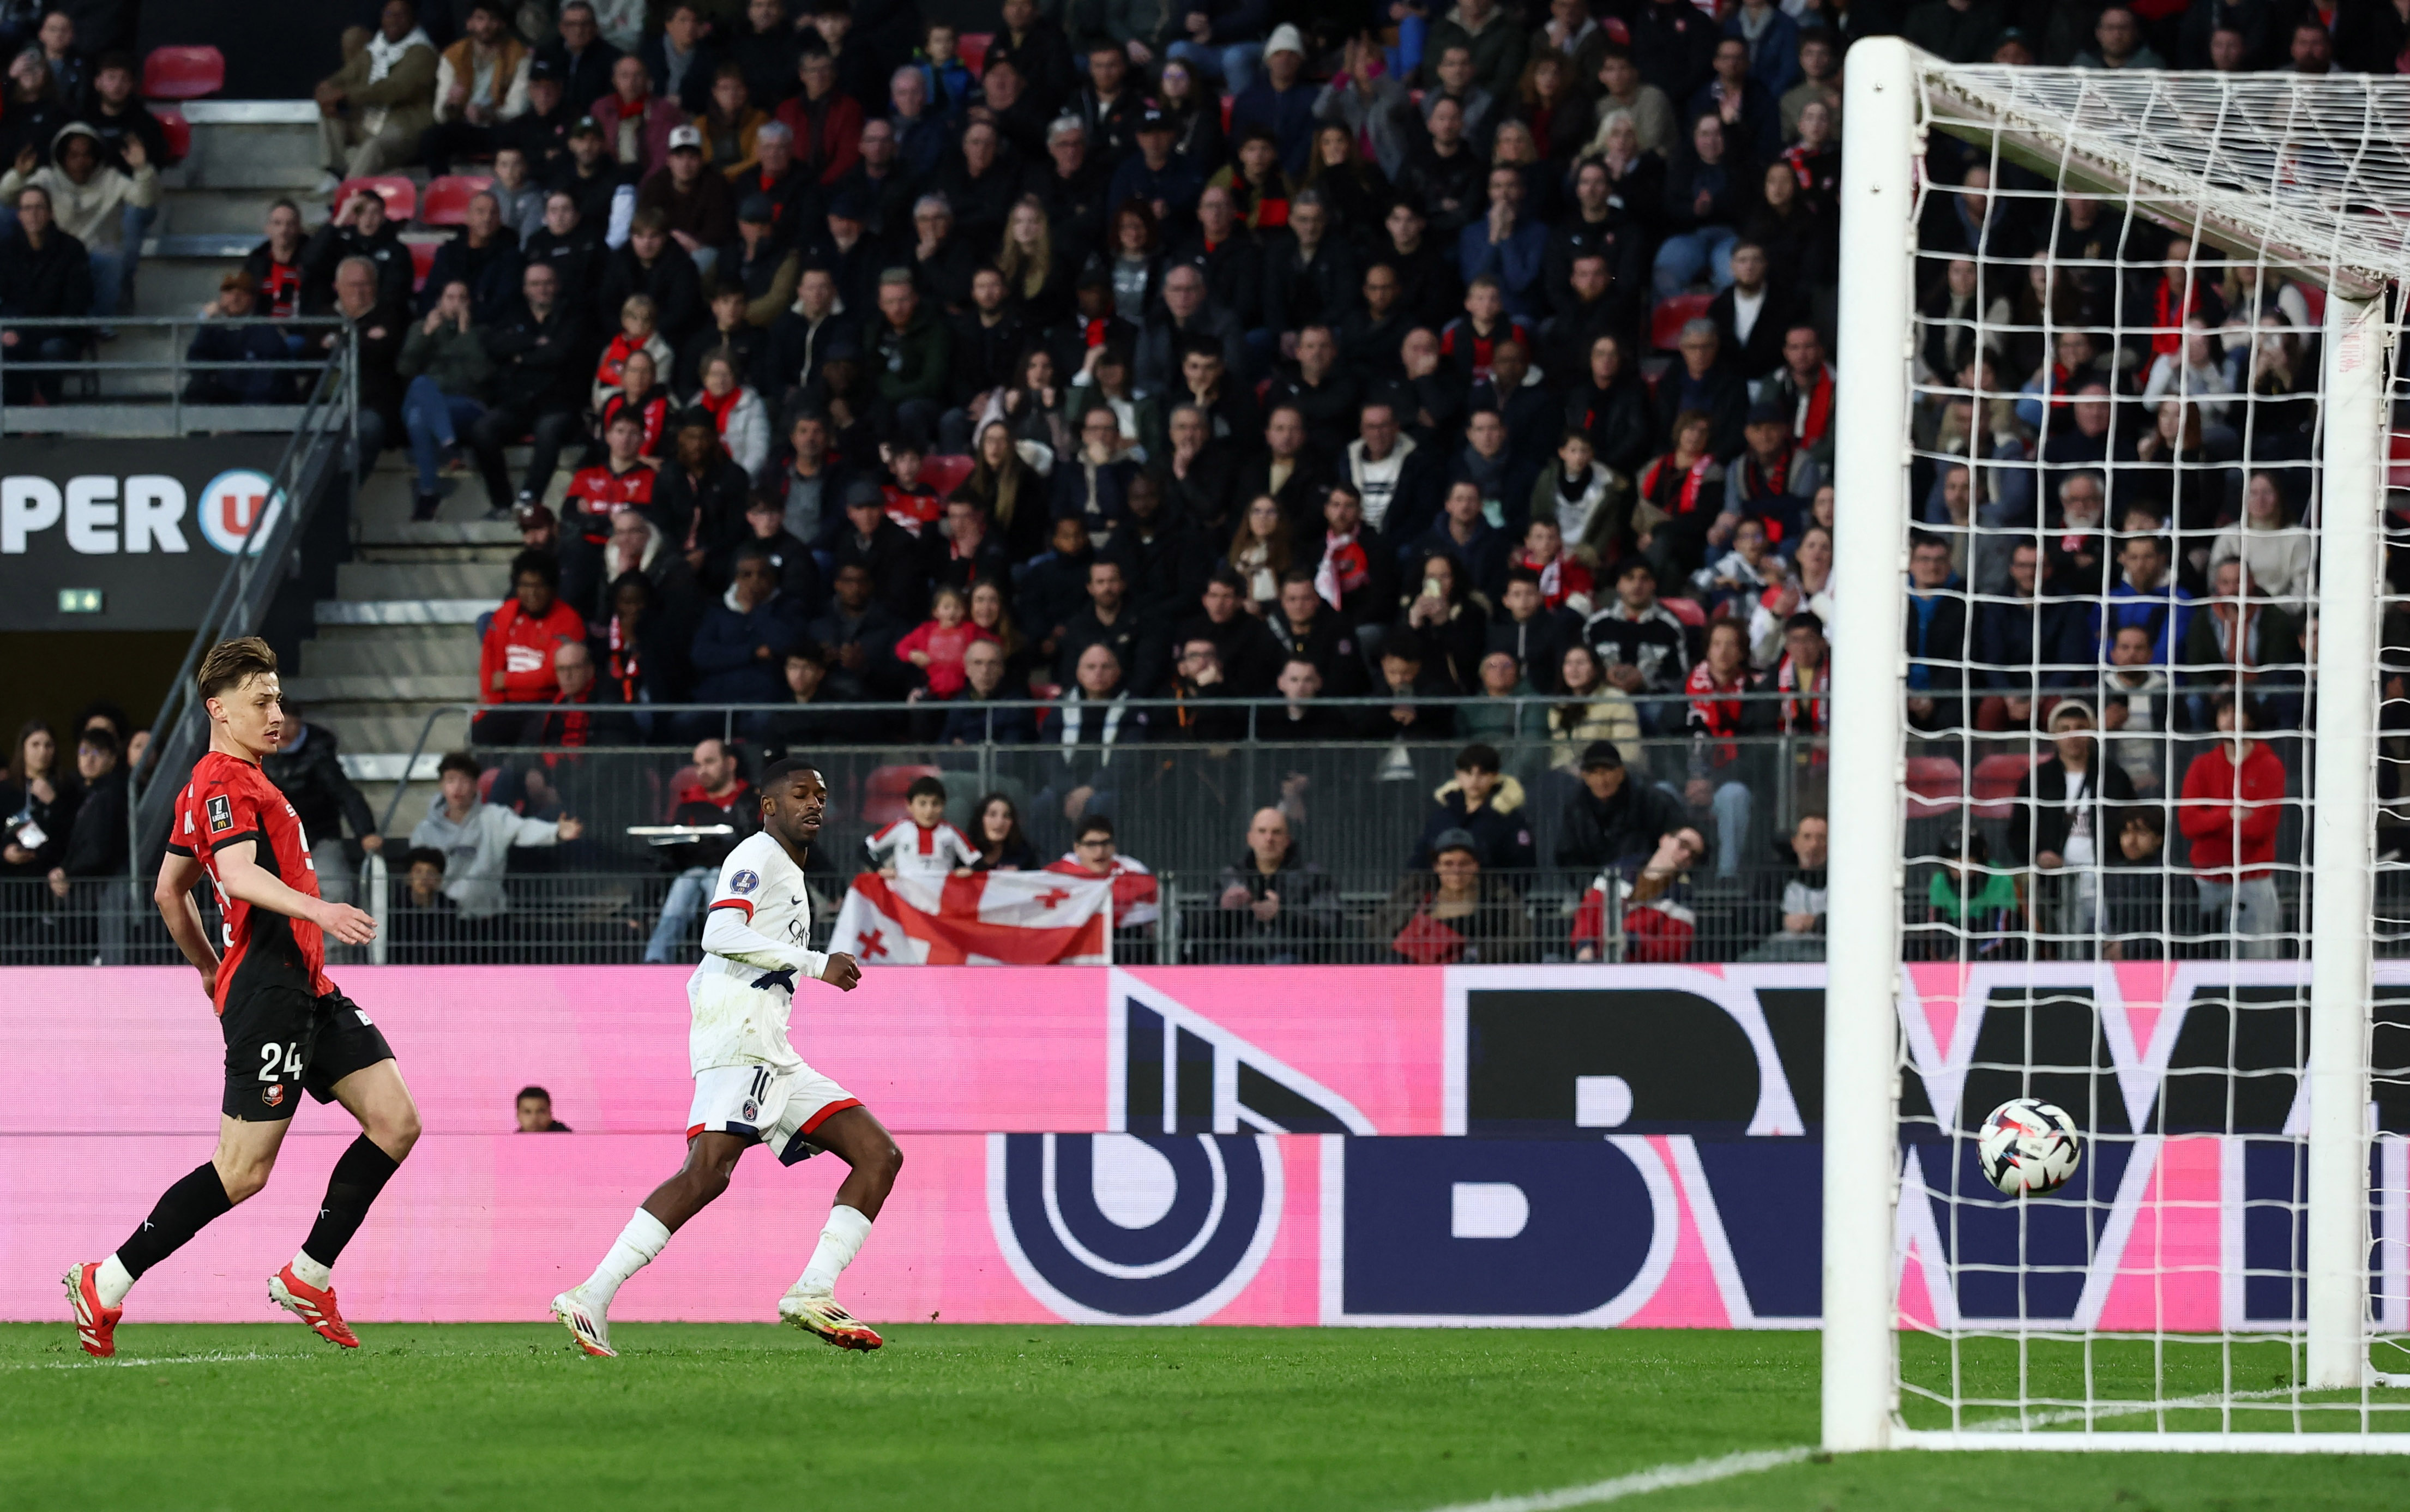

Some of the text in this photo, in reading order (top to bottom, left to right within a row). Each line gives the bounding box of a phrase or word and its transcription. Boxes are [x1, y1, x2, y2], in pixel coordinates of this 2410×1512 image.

[1, 474, 190, 555] PER
[258, 1042, 304, 1082] 24
[750, 1065, 774, 1106] 10
